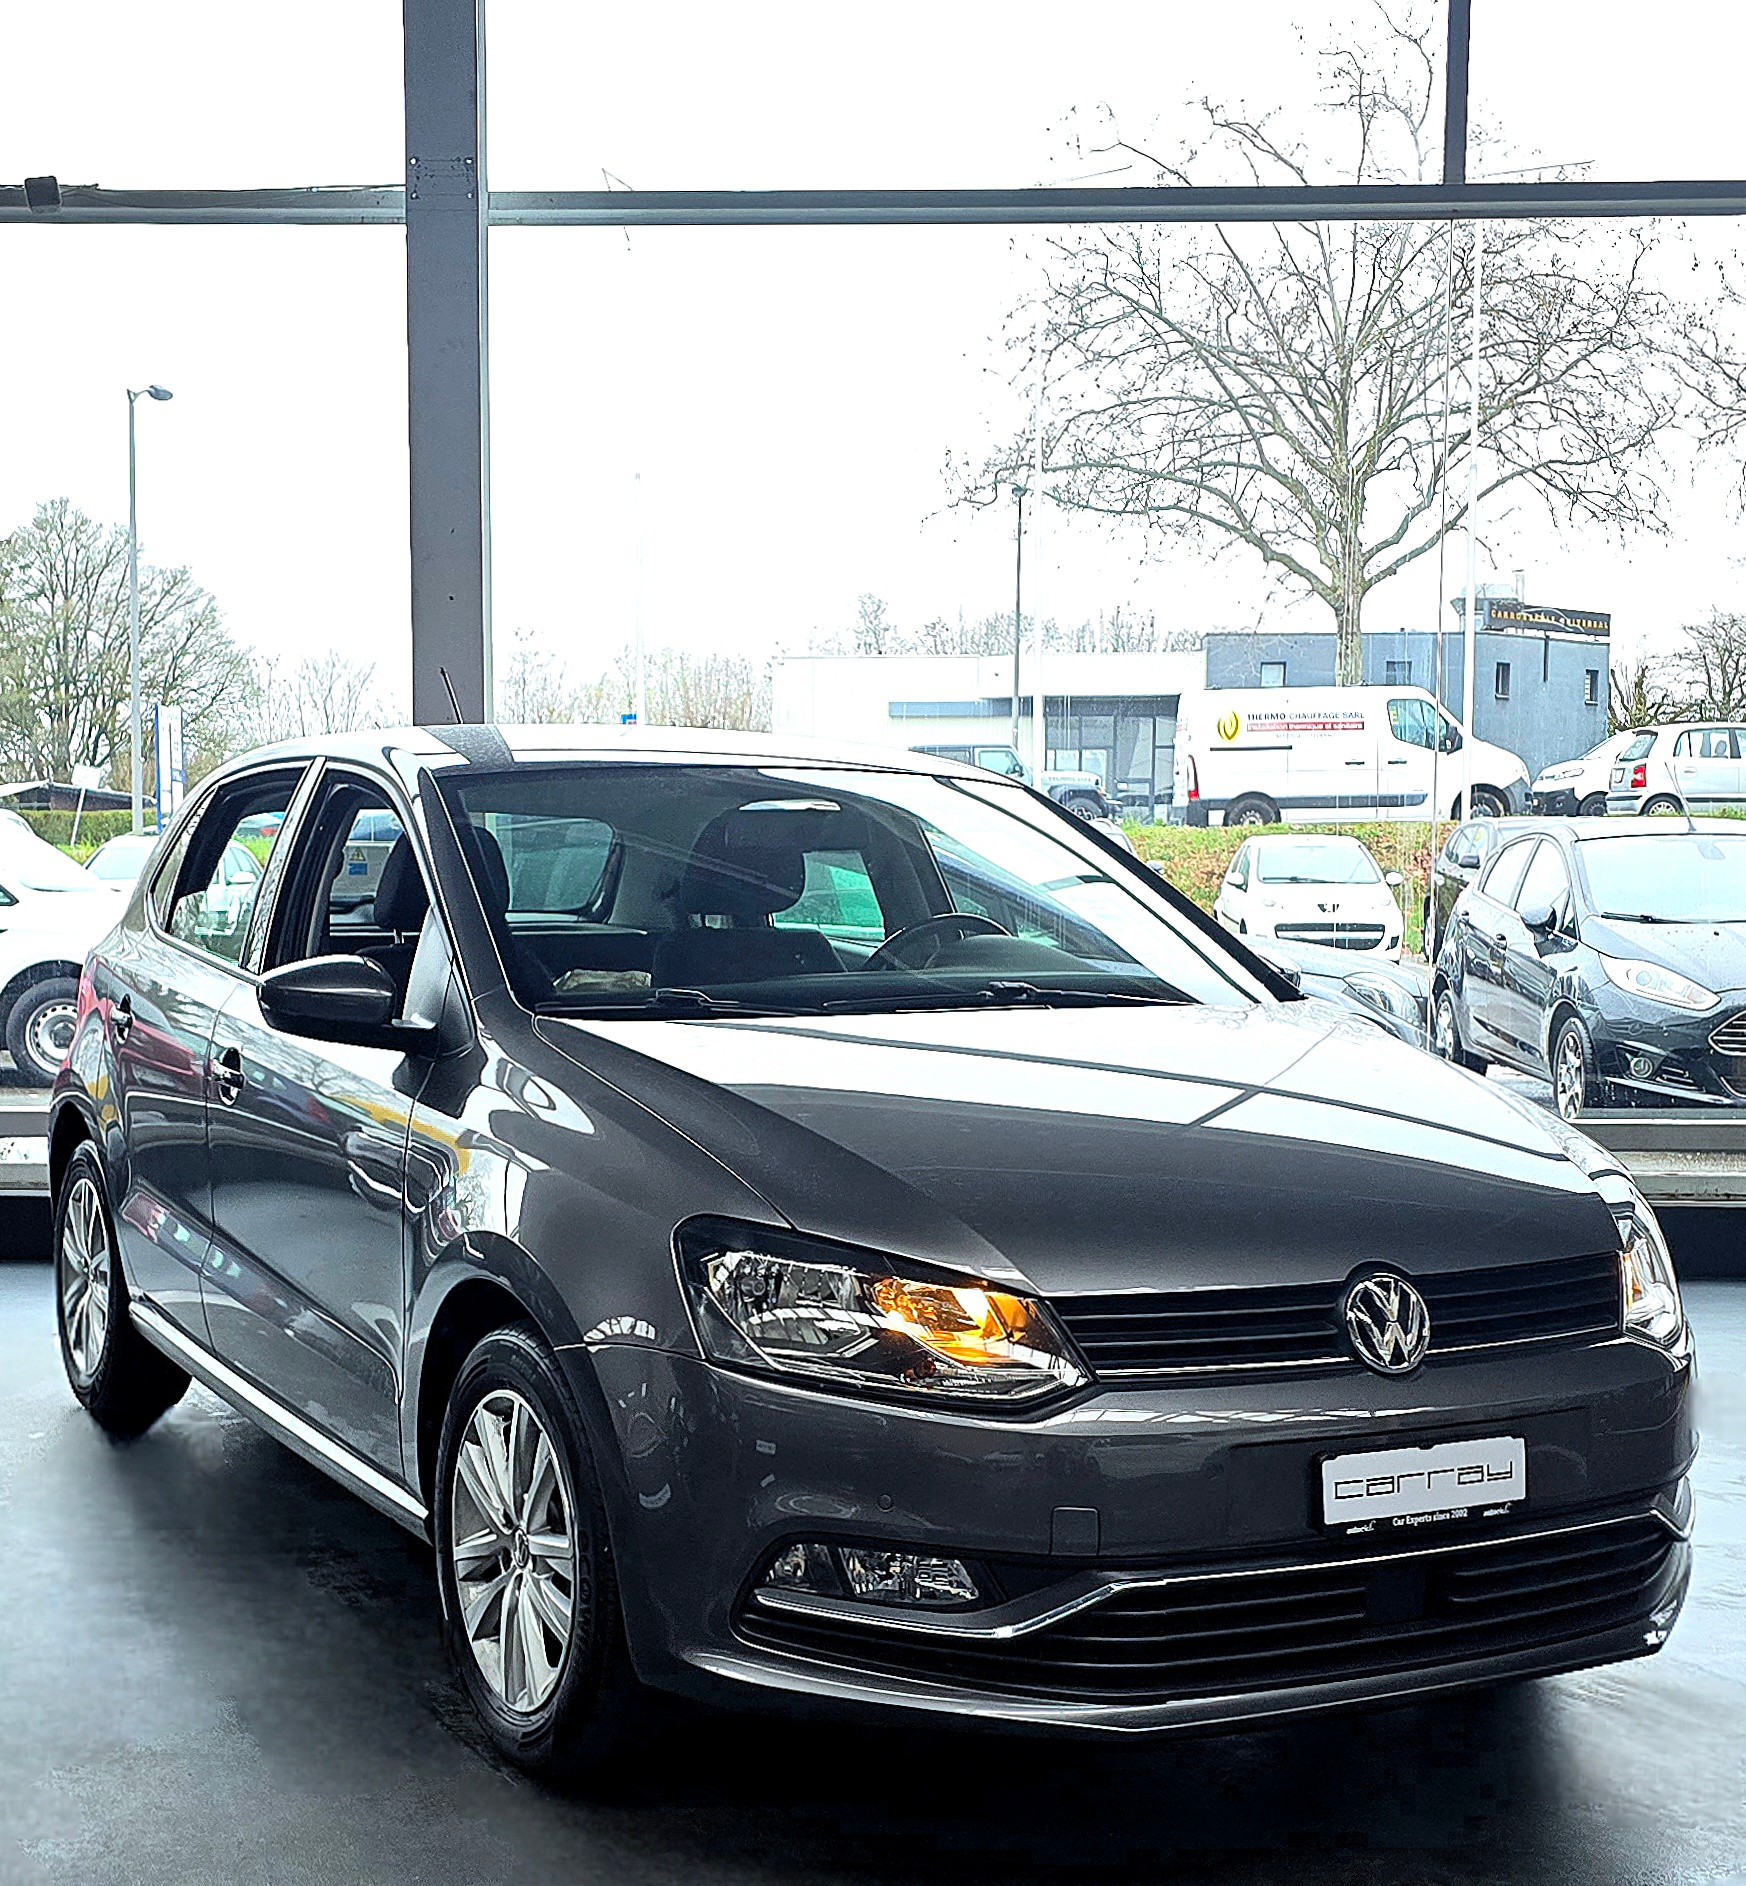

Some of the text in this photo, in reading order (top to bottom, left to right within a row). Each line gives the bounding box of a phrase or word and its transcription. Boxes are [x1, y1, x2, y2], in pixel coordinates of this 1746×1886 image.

[1247, 712, 1286, 721] THERMO
[1334, 1460, 1513, 1500] carray
[1392, 1508, 1468, 1527] Car Experts since 2002
